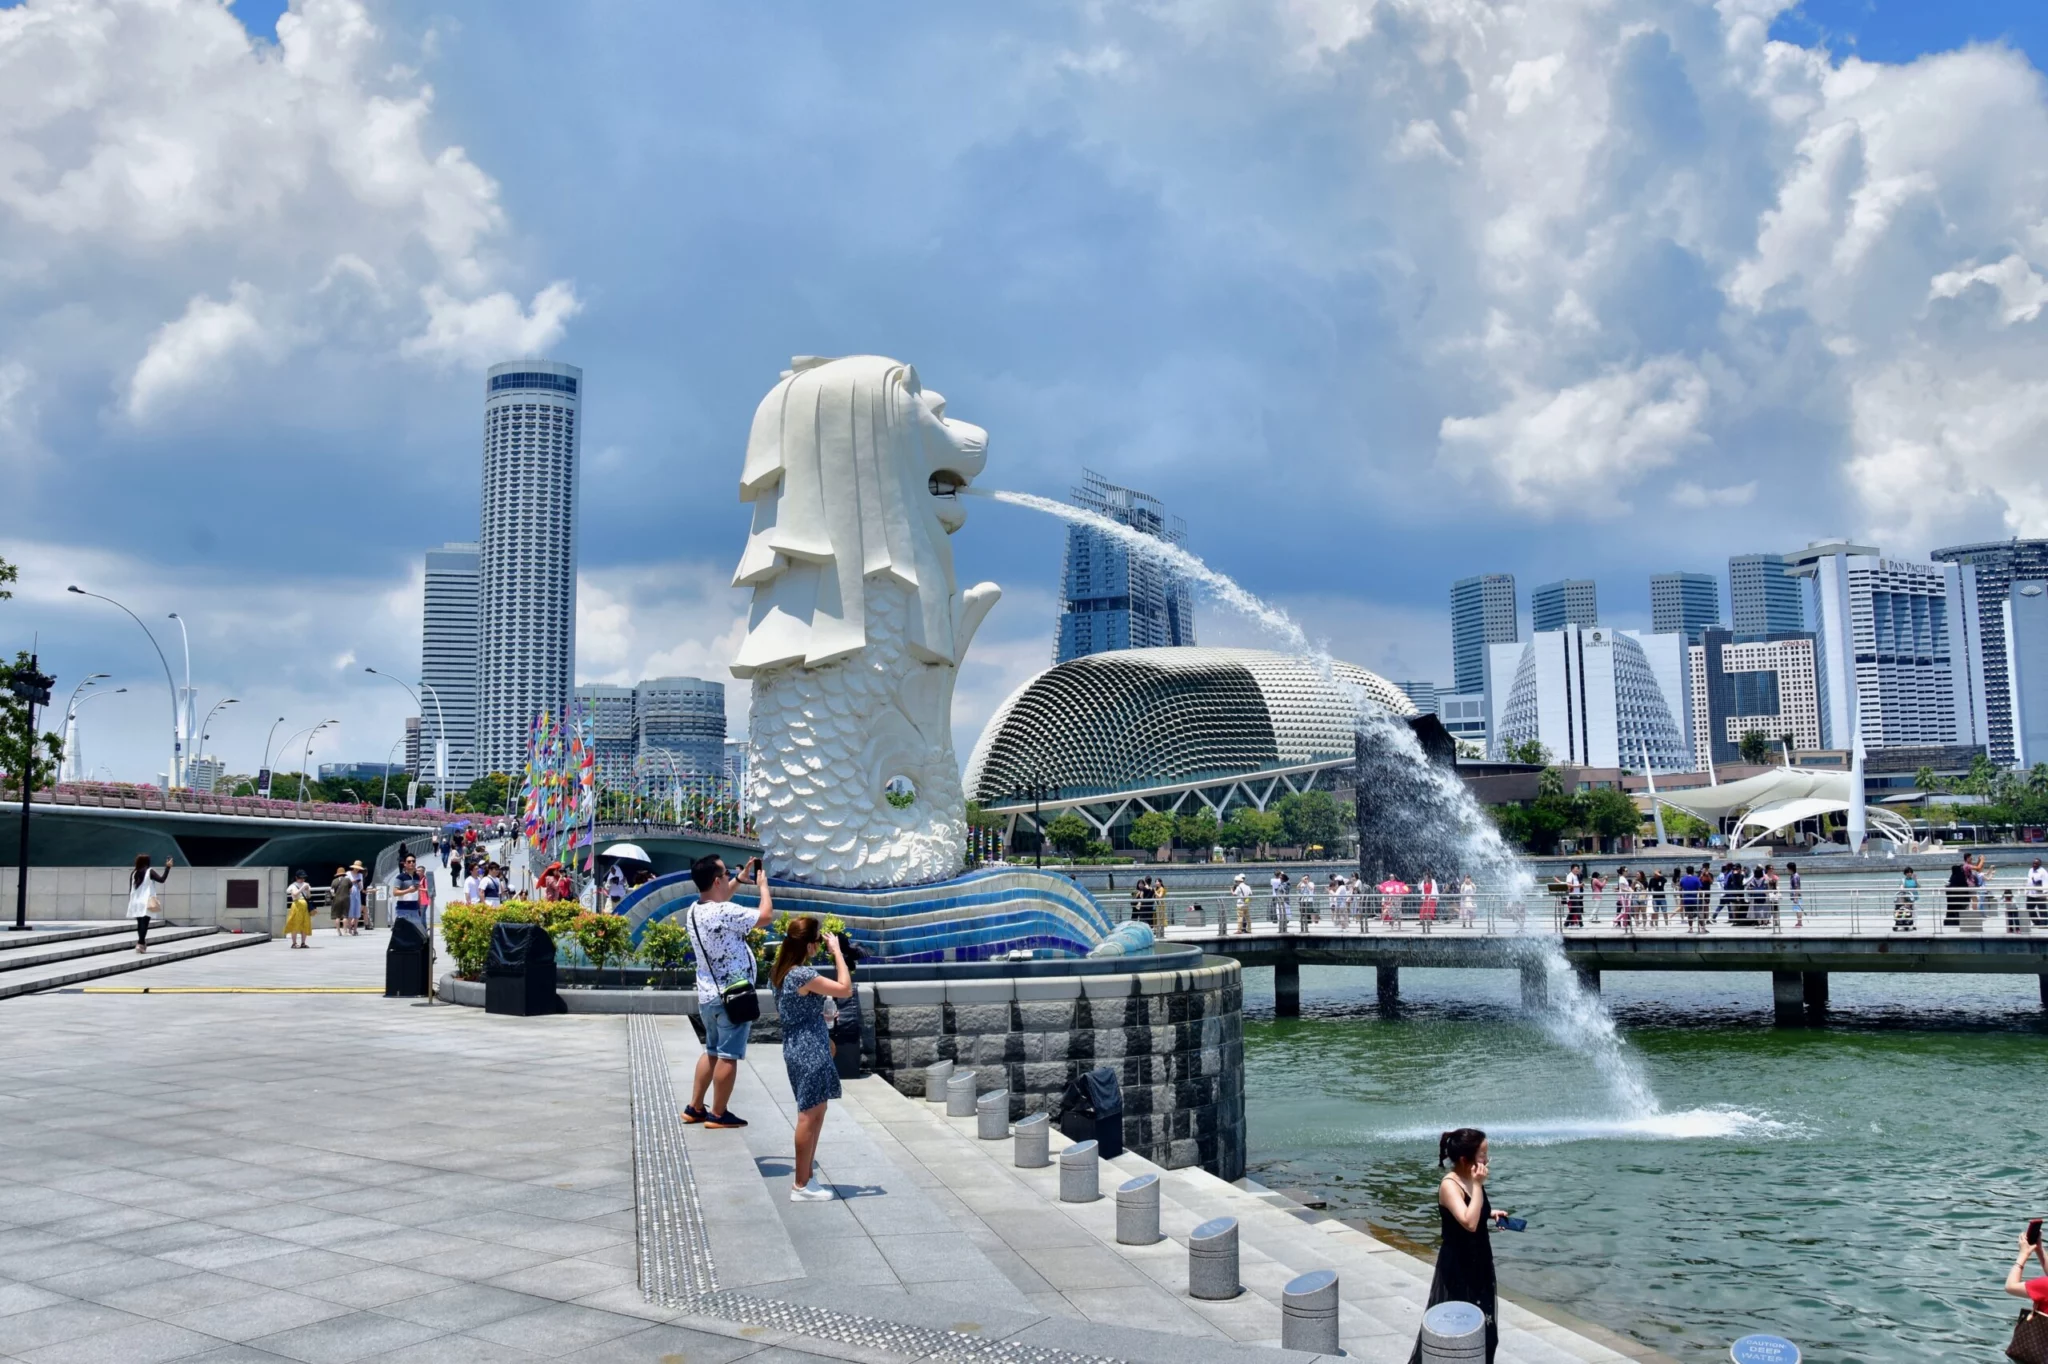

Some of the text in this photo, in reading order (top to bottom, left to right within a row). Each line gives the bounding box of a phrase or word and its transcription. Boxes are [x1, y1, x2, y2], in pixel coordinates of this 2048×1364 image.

[1972, 553, 1998, 564] SMBC
[1889, 560, 1935, 574] PAN PACIFIC
[1746, 1340, 1785, 1349] CAUTION
[1749, 1346, 1781, 1355] DEEP
